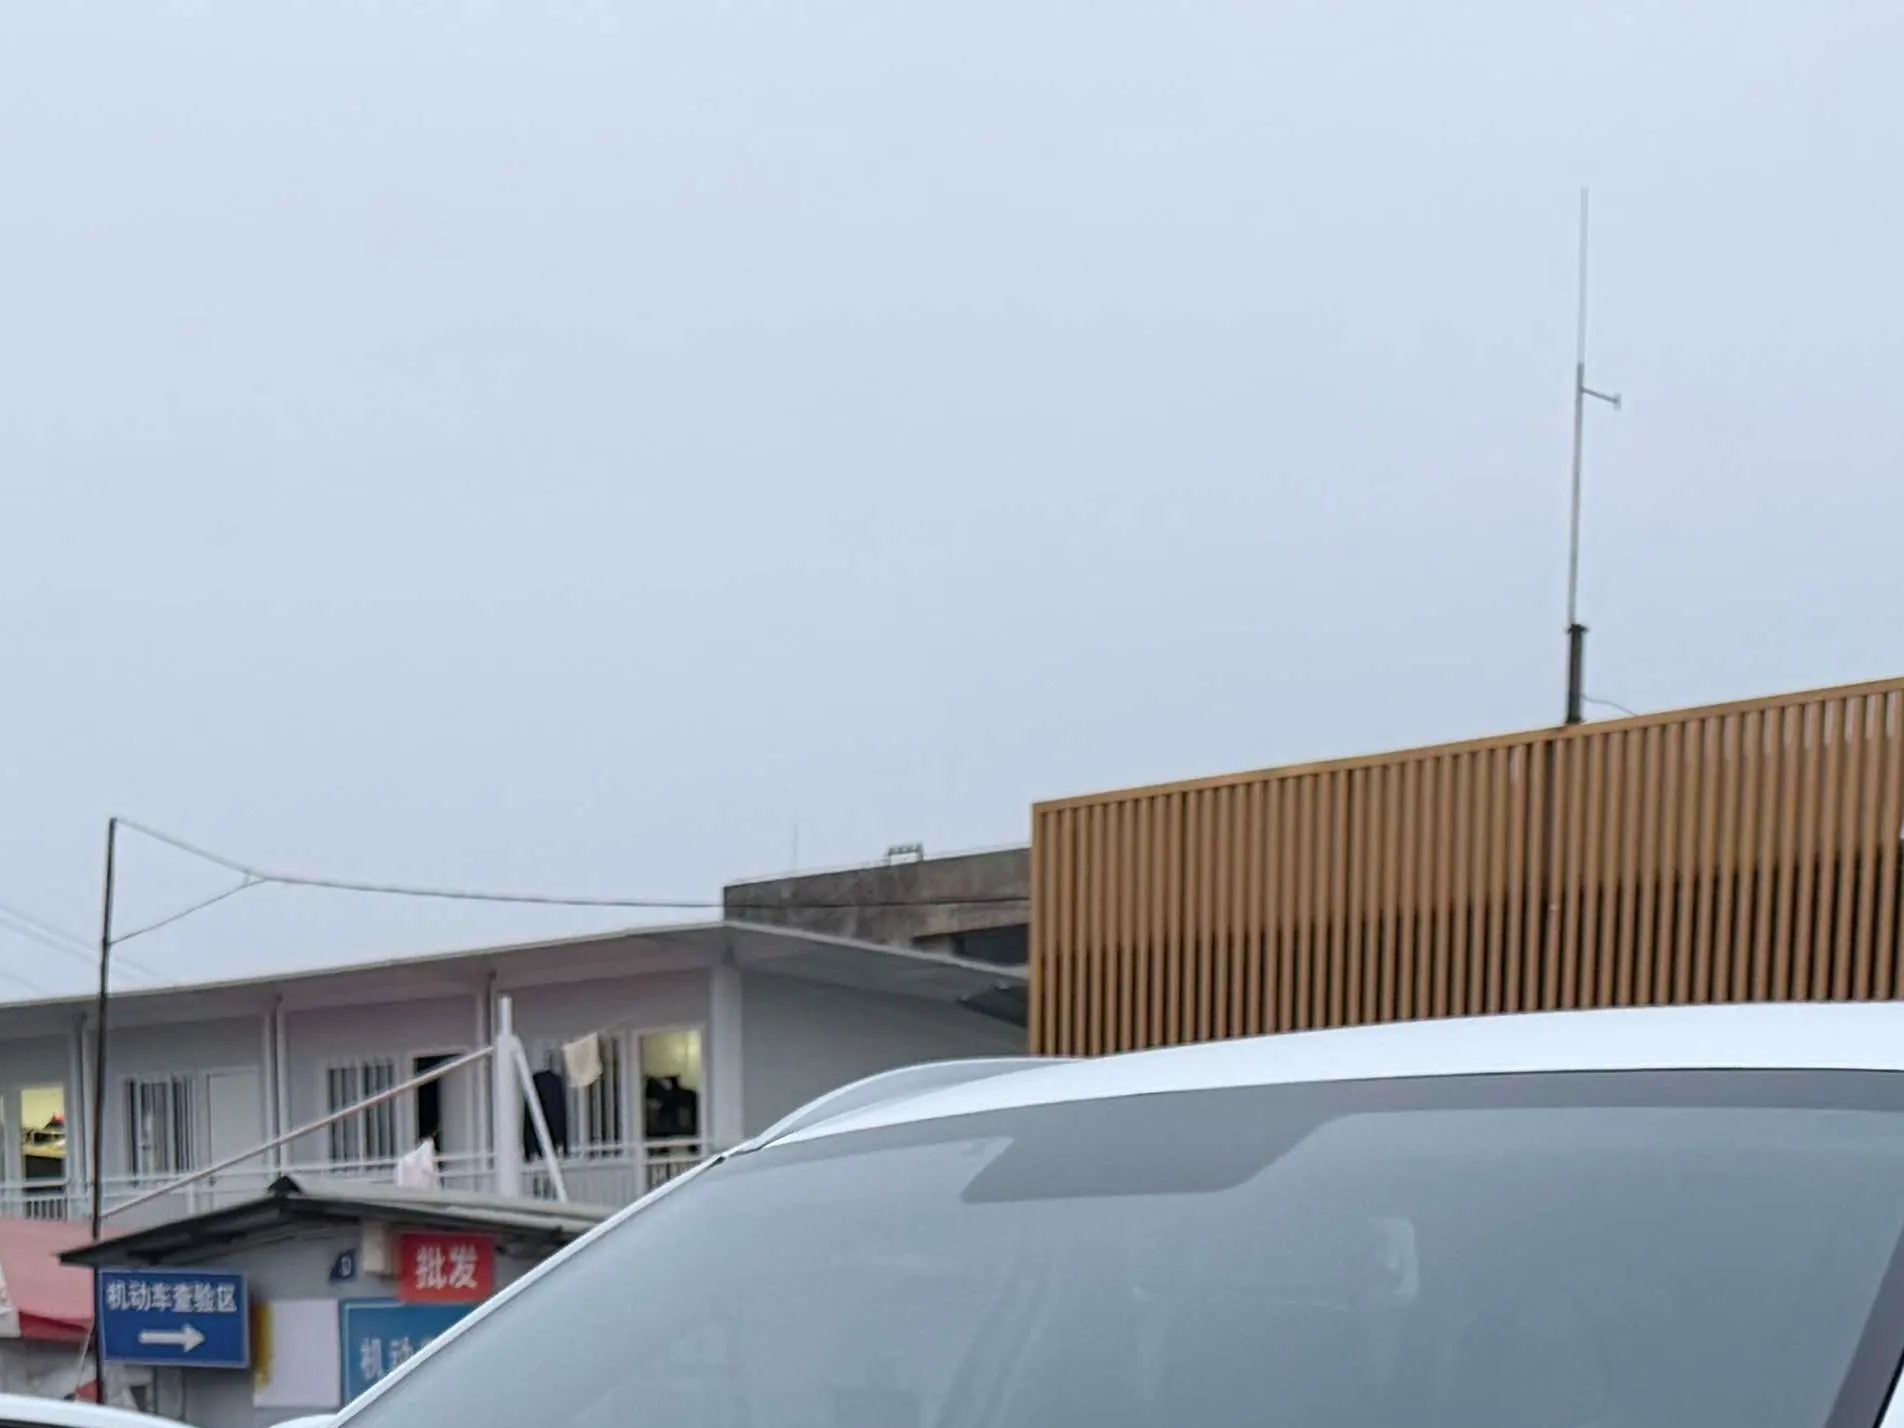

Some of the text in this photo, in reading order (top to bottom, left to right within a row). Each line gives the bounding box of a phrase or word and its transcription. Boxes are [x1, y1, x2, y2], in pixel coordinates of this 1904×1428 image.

[415, 1244, 479, 1290] 批发
[106, 1279, 238, 1313] 机动车查验区
